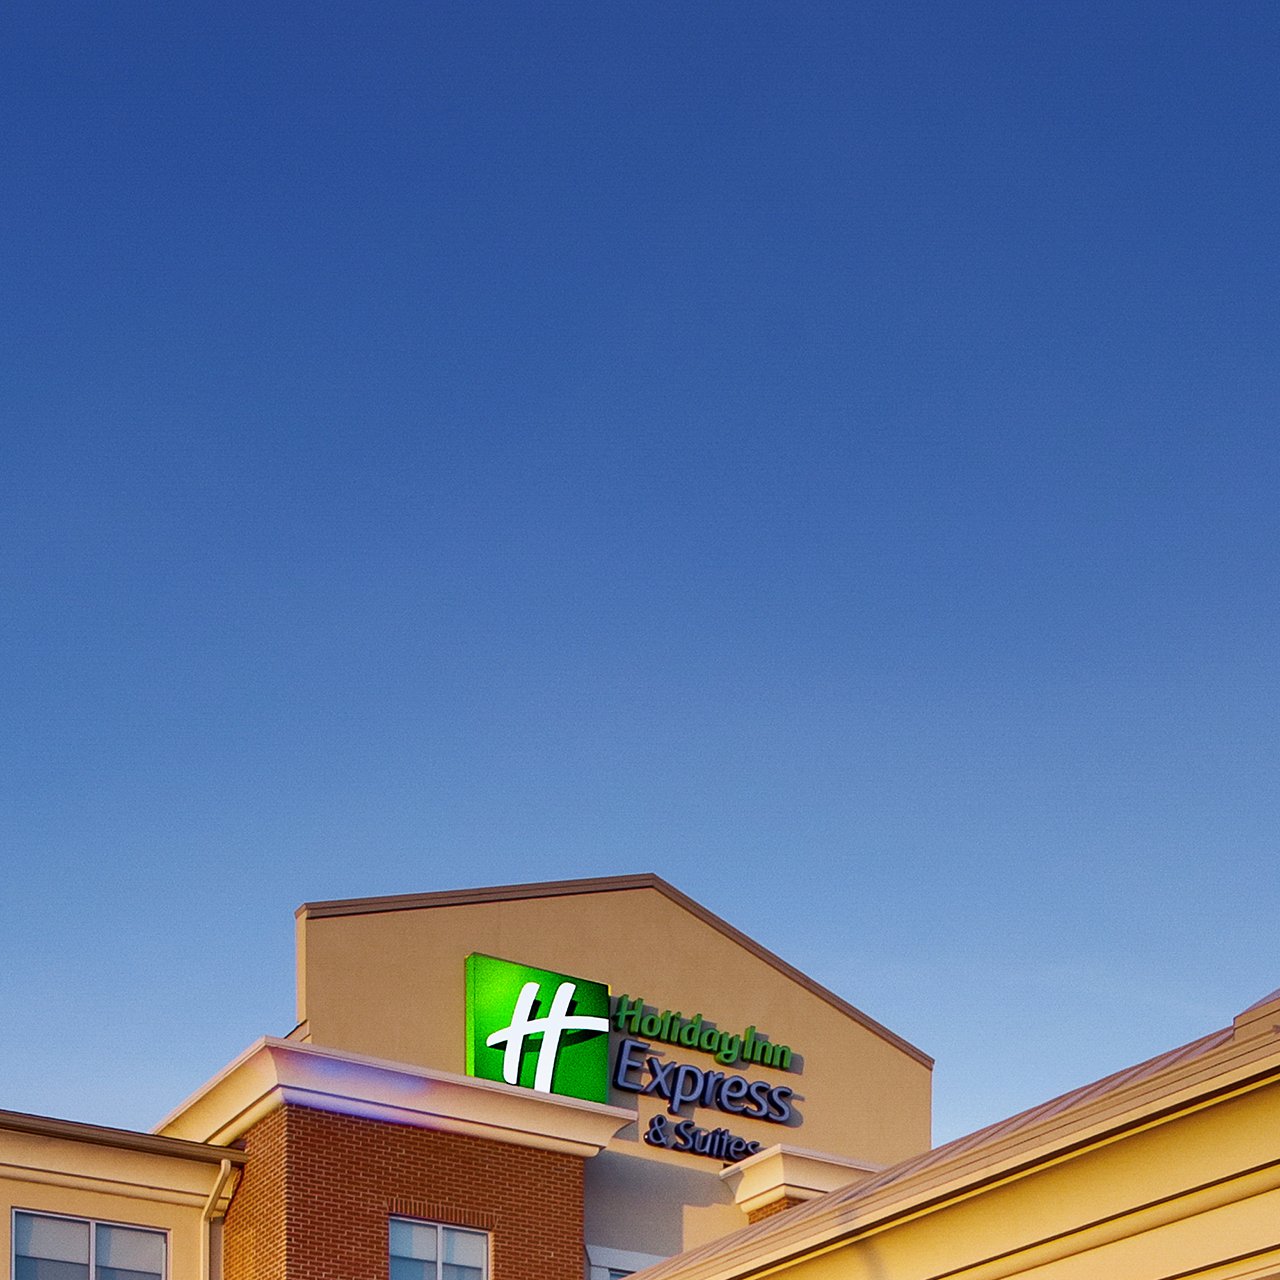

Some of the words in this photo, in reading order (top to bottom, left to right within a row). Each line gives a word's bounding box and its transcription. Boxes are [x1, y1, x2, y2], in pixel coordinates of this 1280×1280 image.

[613, 993, 741, 1064] Holiday
[741, 1024, 794, 1070] Inn
[613, 1039, 794, 1124] Express
[645, 1114, 668, 1147] &
